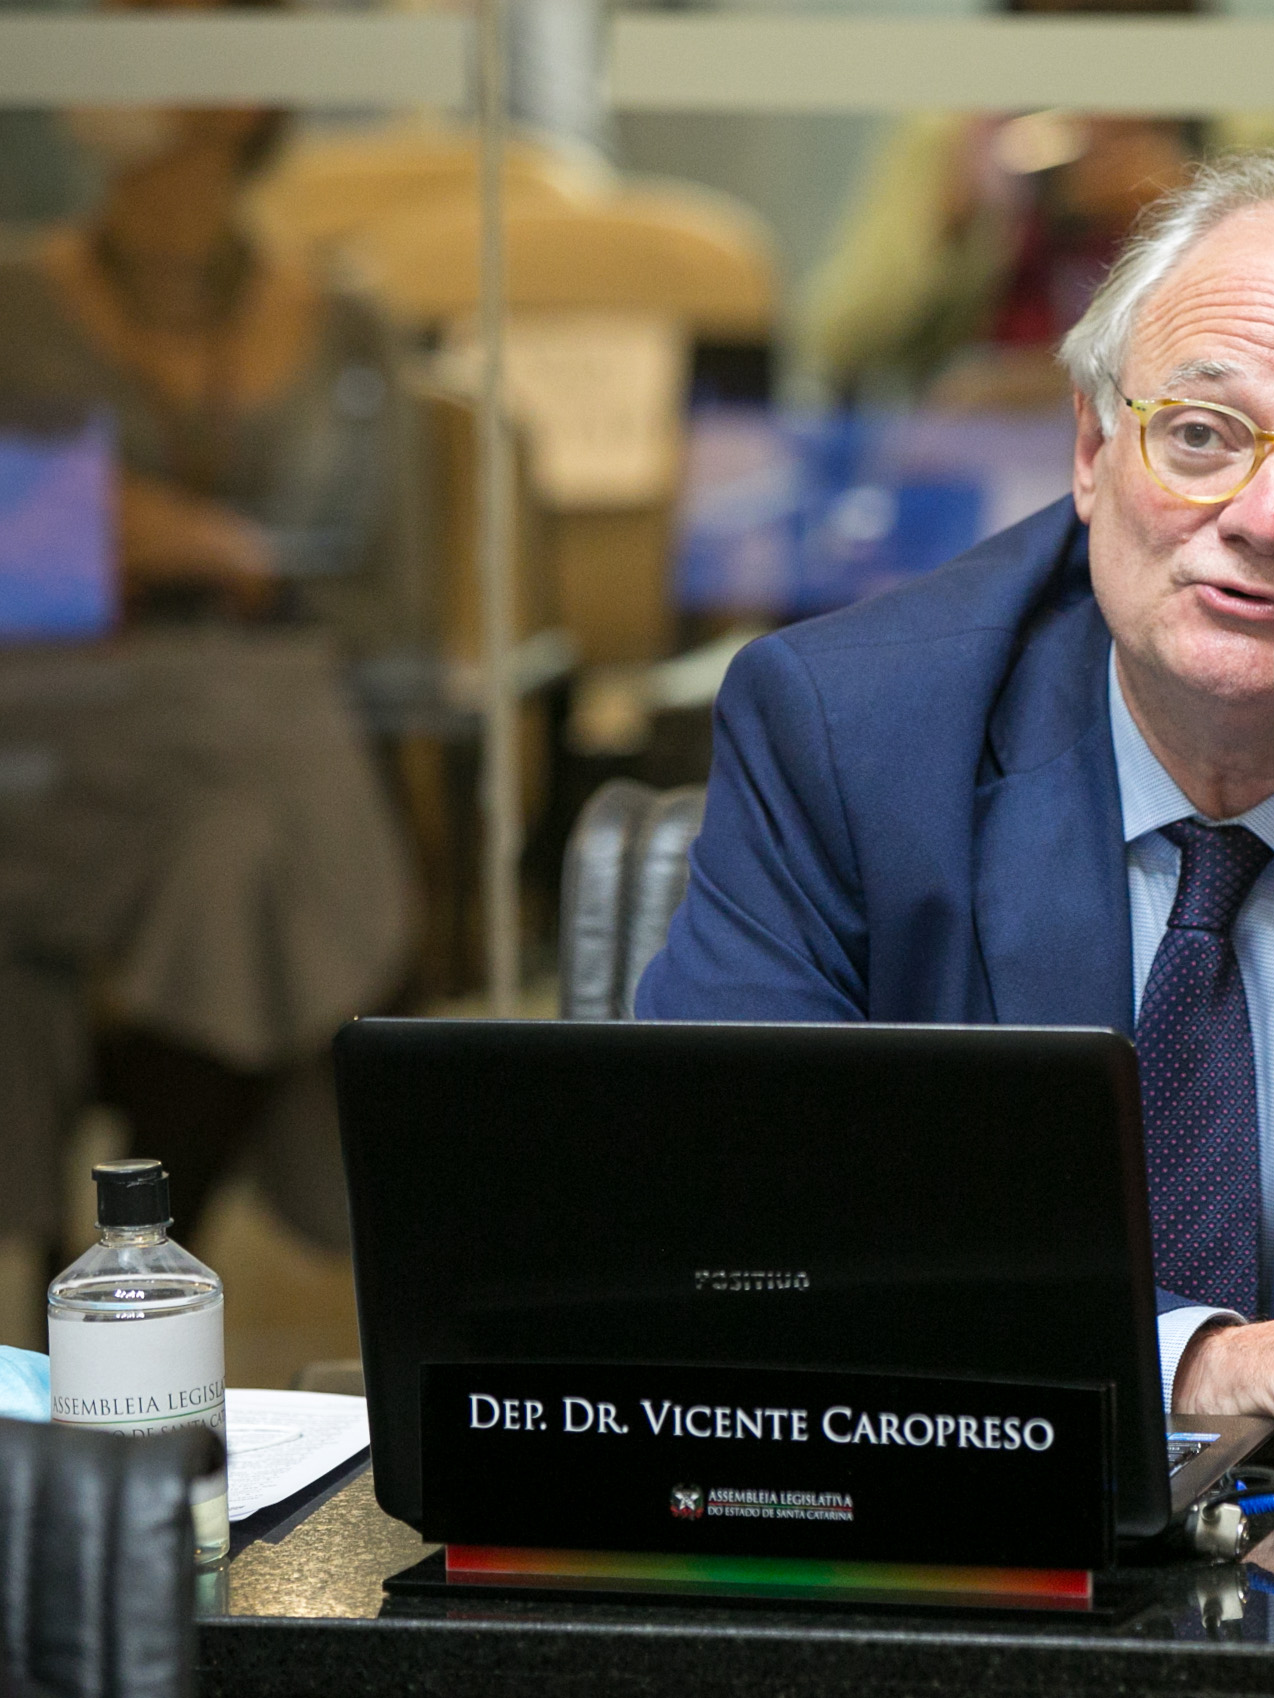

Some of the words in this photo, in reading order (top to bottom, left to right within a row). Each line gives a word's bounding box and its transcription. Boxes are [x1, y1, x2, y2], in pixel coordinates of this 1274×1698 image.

[53, 1396, 159, 1416] ASSEMBLEIA
[469, 1393, 547, 1431] DEP.
[563, 1397, 629, 1434] DR.
[640, 1399, 808, 1441] VICENTE
[822, 1405, 1054, 1451] CAROPRESO
[708, 1490, 777, 1503] ASSEMBLEIA
[780, 1492, 852, 1507] LEGISLATIVA
[708, 1506, 723, 1516] DO
[725, 1506, 760, 1518] ESTADO
[762, 1509, 775, 1519] DE
[776, 1510, 806, 1520] SANTA
[806, 1511, 853, 1522] CATARINA
